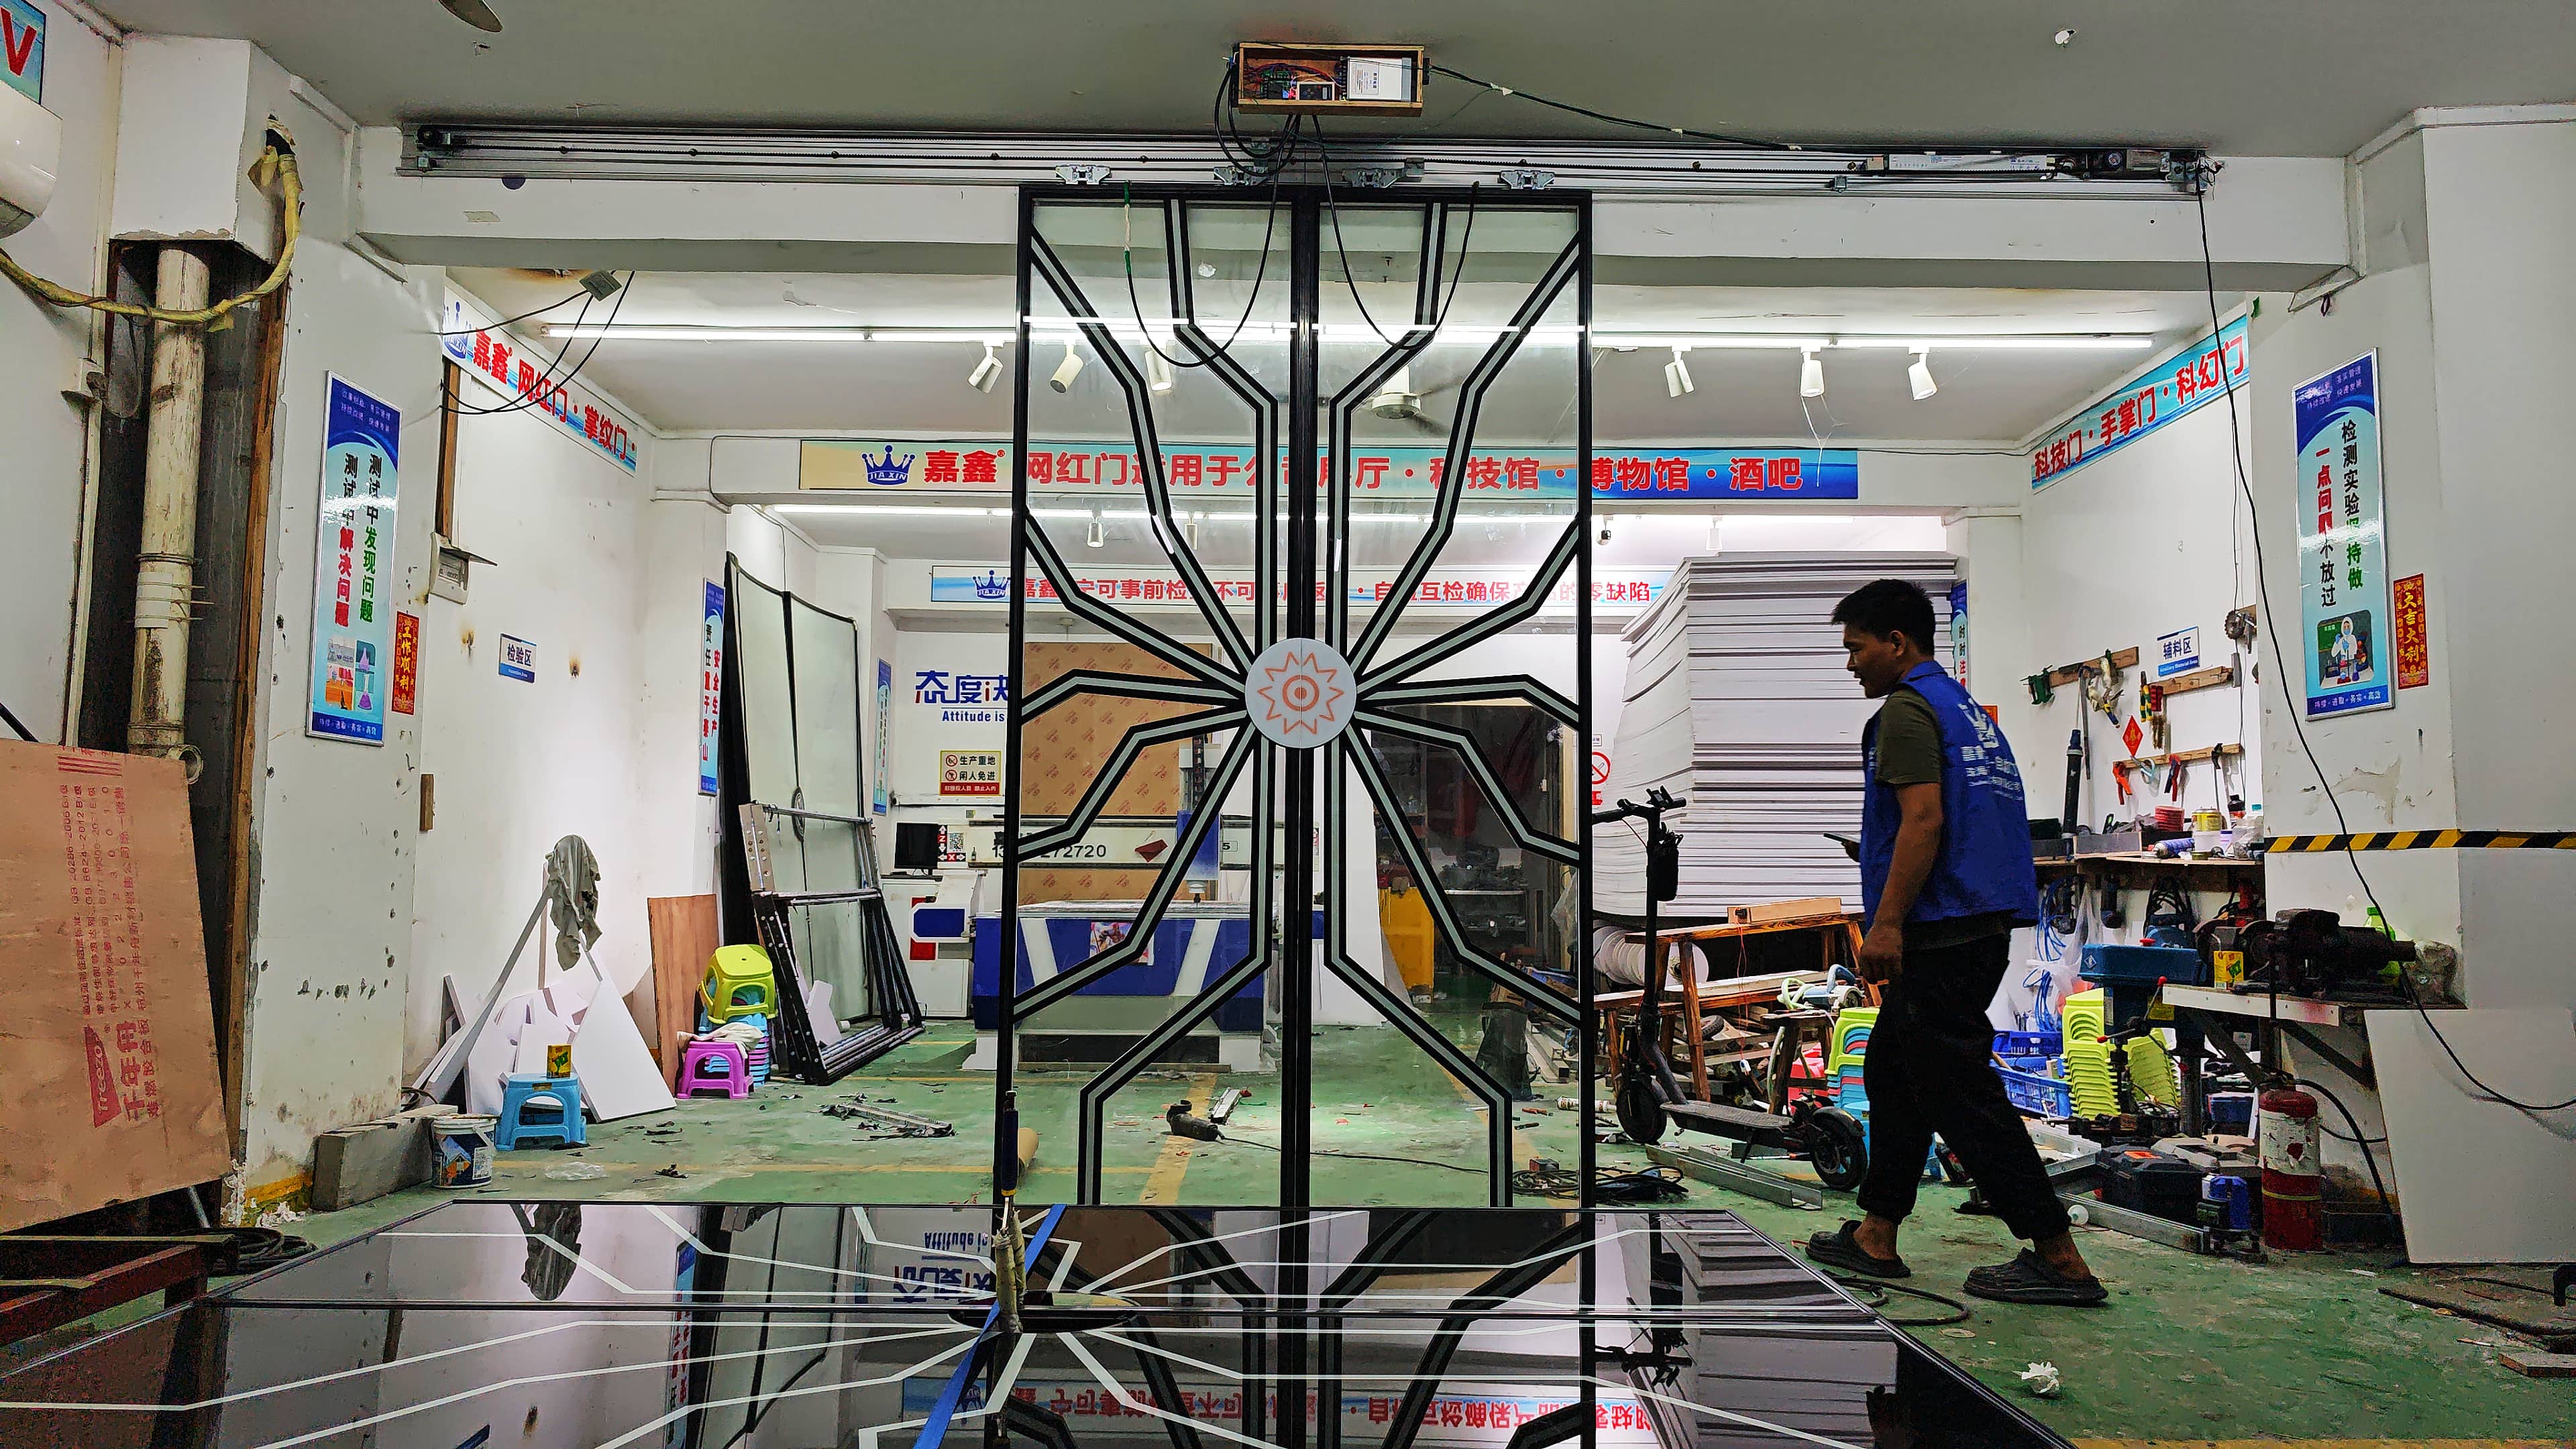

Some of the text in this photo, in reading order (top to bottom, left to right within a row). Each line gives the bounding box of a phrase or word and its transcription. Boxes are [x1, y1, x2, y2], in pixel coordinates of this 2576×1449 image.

[456, 339, 466, 355] XIN
[923, 449, 998, 483] 嘉鑫
[869, 472, 906, 480] JIA XIN
[2163, 636, 2192, 661] 辅料区
[507, 643, 532, 667] 检验区
[942, 710, 1005, 722] Attitude is
[960, 755, 996, 765] 生产重地
[959, 771, 996, 781] 闲人免进
[939, 835, 946, 843] Z
